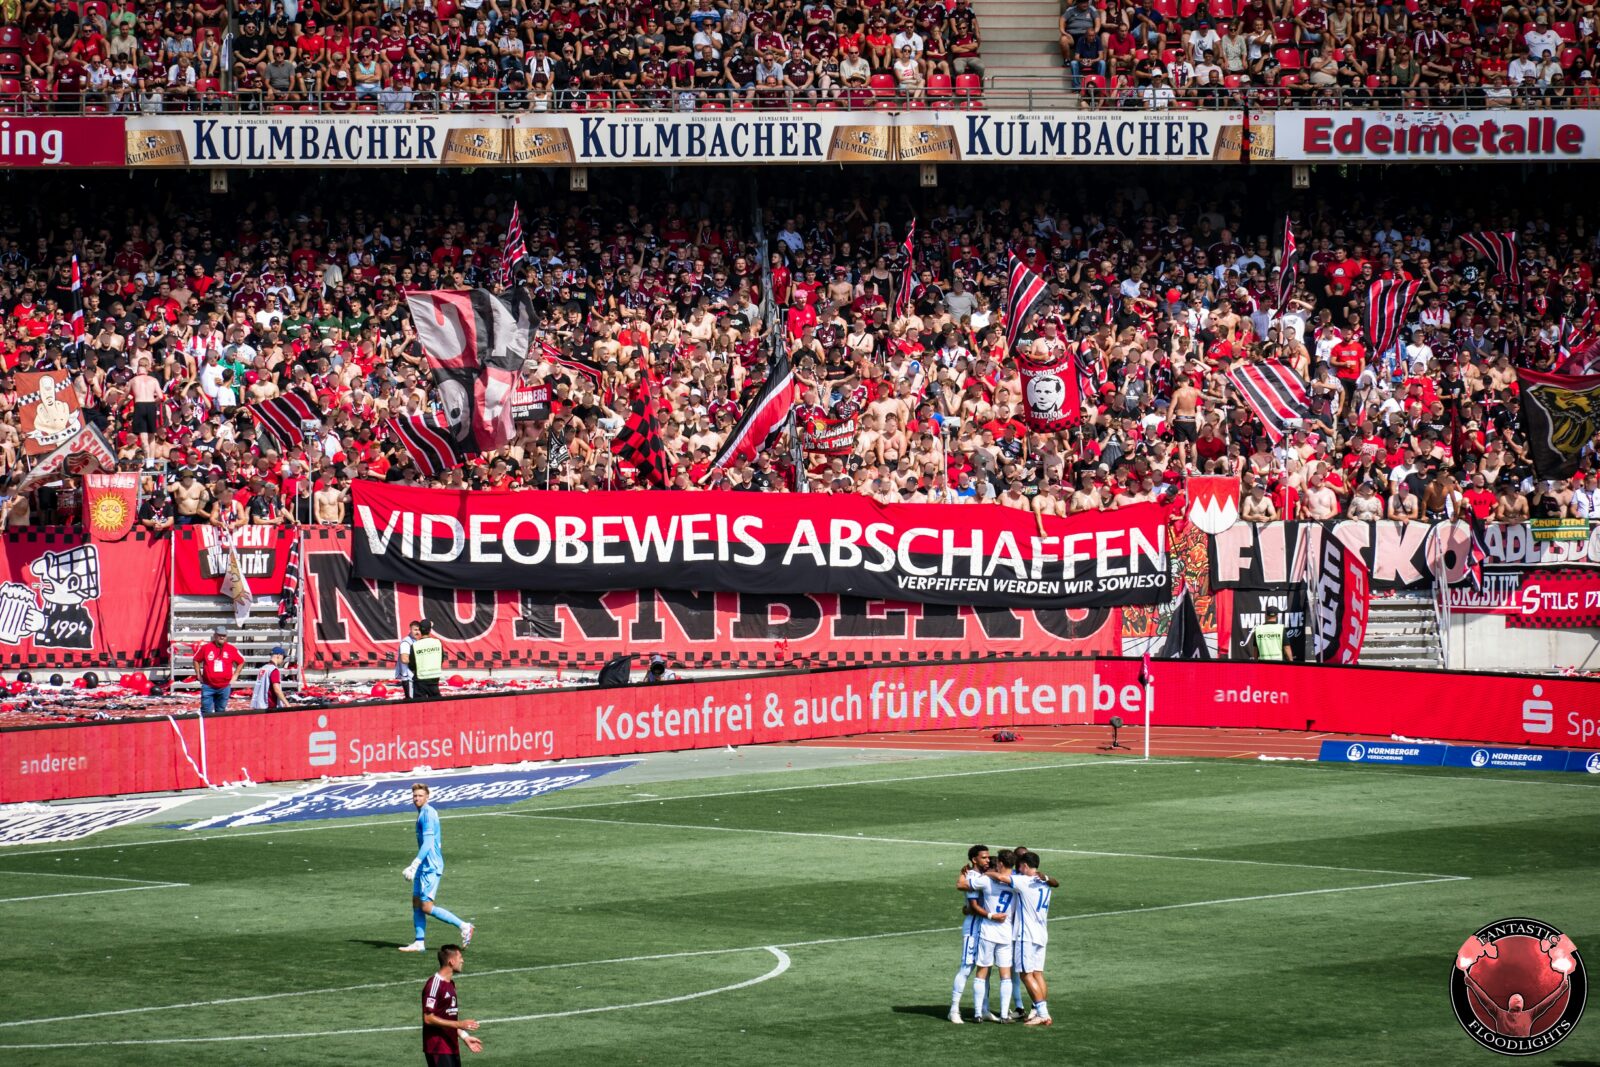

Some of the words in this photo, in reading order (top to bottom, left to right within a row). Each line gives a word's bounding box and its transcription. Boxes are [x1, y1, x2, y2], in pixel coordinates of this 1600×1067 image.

[1, 121, 63, 163] ing
[193, 119, 437, 160] KULMBACHER
[580, 117, 823, 157] KULMBACHER
[966, 115, 1209, 156] KULMBACHER
[127, 144, 181, 164] KULMBACHER
[448, 142, 503, 161] KULMBACHER
[513, 141, 569, 162] KULMBACHER
[834, 138, 889, 159] KULMBACHER
[1220, 138, 1275, 157] KULACHER
[202, 524, 273, 547] RESPEKT
[357, 505, 766, 566] VIDEOBEWEIS
[782, 519, 1167, 580] ABSCHAFFEN
[897, 575, 989, 592] VERPFIFFEN
[993, 578, 1060, 595] WERDEN
[1064, 578, 1094, 593] WIR
[1097, 574, 1167, 592] SOWIESO
[1258, 595, 1288, 611] YOU
[51, 620, 87, 639] 1994
[1214, 685, 1289, 704] anderen
[596, 692, 752, 741] Kostenfrei
[763, 692, 785, 728] &
[793, 684, 862, 726] auch
[1567, 711, 1600, 742] Sp
[349, 734, 453, 768] Sparkasse
[460, 726, 554, 755] Nürnberg
[20, 753, 88, 774] anderen
[996, 890, 1013, 913] 9
[1036, 888, 1050, 912] 14
